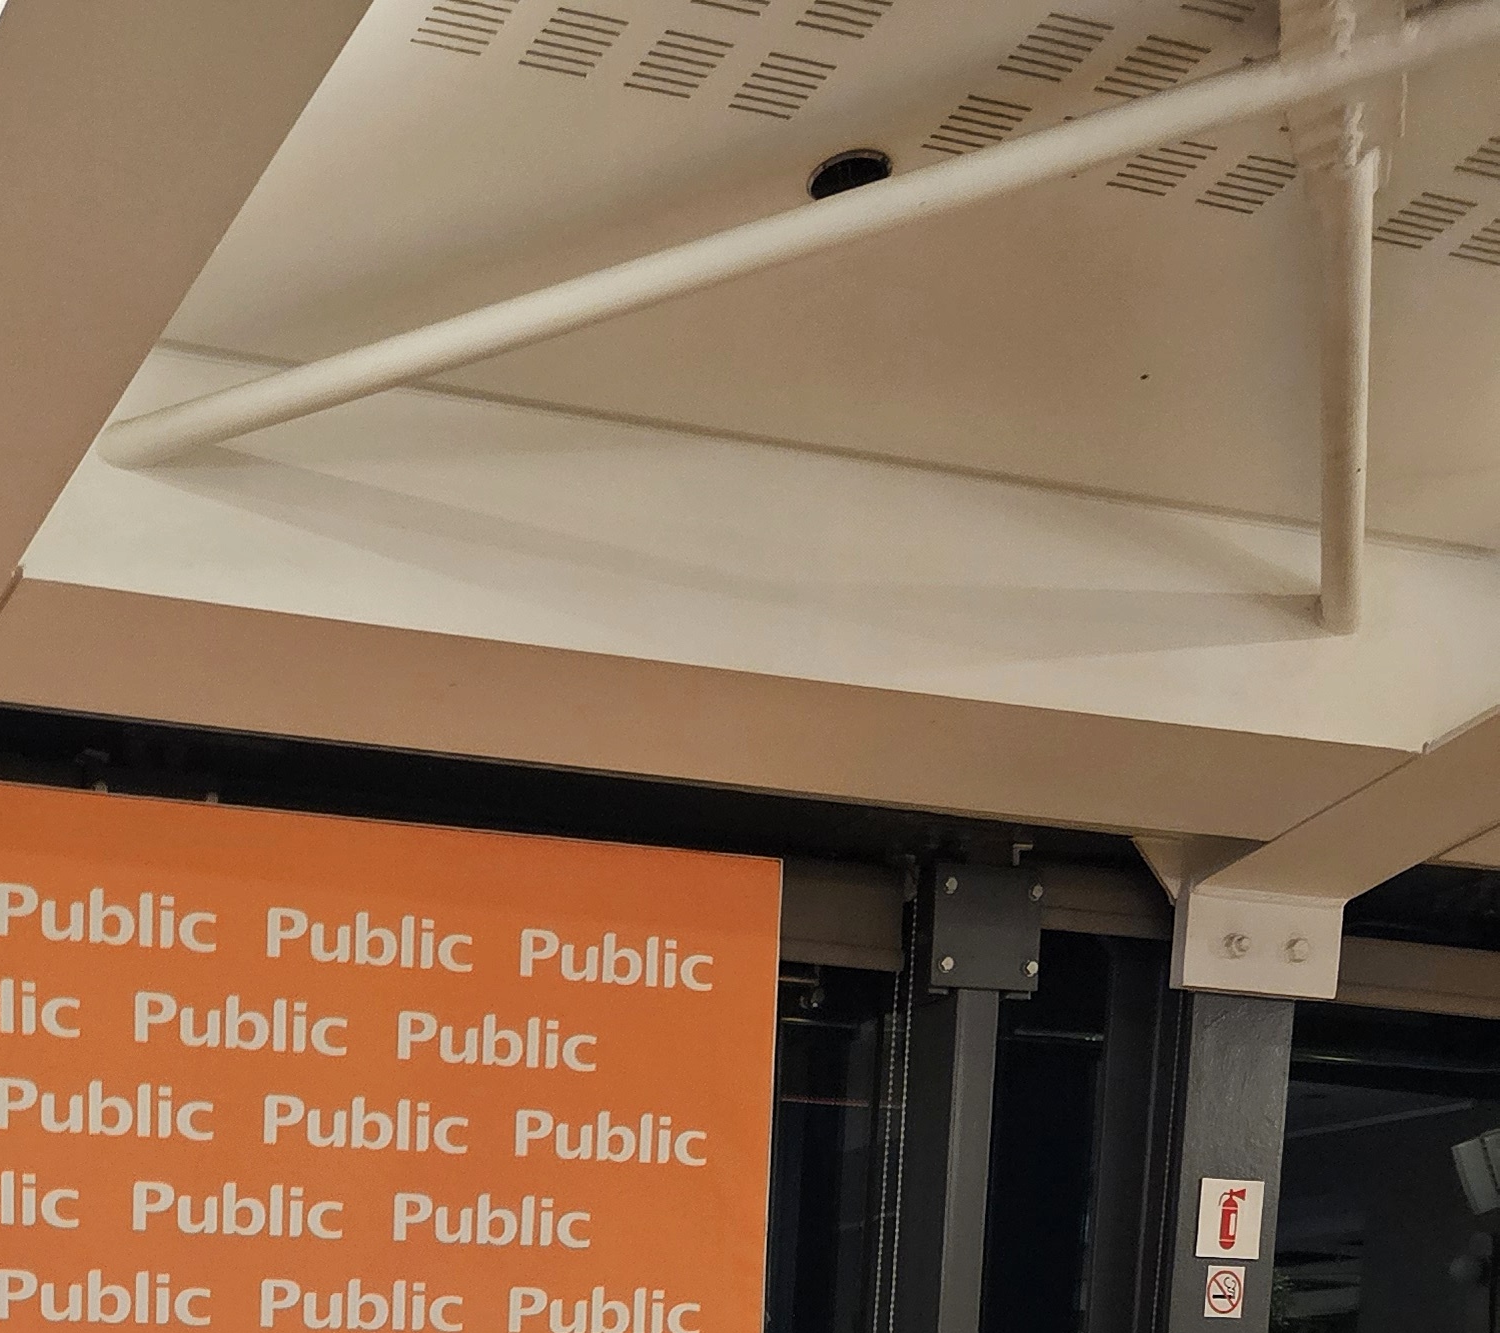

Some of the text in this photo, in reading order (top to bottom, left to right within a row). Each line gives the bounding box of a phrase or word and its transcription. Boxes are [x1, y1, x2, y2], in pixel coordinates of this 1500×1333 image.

[267, 908, 471, 971] Public
[520, 929, 712, 990] Public
[135, 992, 347, 1055] Public
[398, 1011, 596, 1071] Public
[264, 1094, 468, 1153] Public
[516, 1110, 705, 1165] Public
[133, 1182, 342, 1239] Public
[394, 1193, 589, 1248] Public
[260, 1279, 462, 1332] Public
